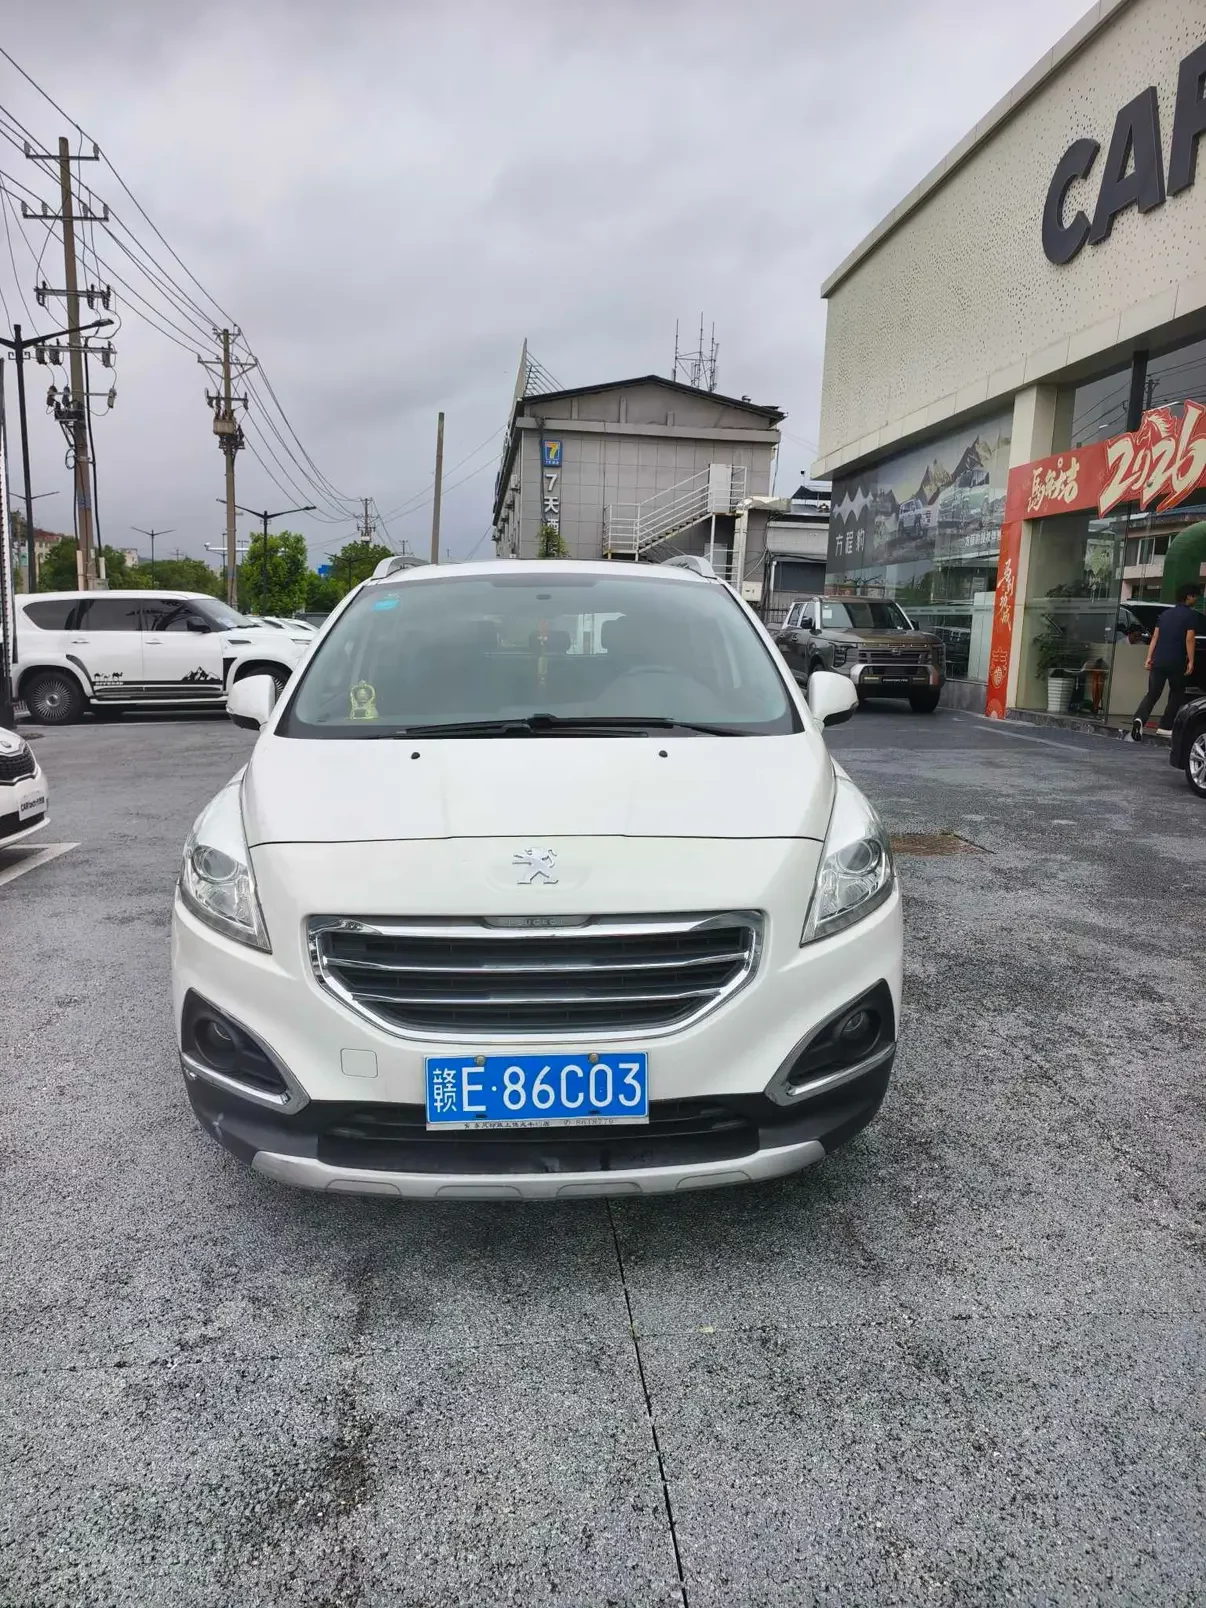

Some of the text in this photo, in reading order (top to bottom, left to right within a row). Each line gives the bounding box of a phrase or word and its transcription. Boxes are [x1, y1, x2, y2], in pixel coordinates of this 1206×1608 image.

[1099, 402, 1206, 515] 2026
[835, 529, 865, 557] 方程豹
[432, 1062, 642, 1113] 赣E·86C03
